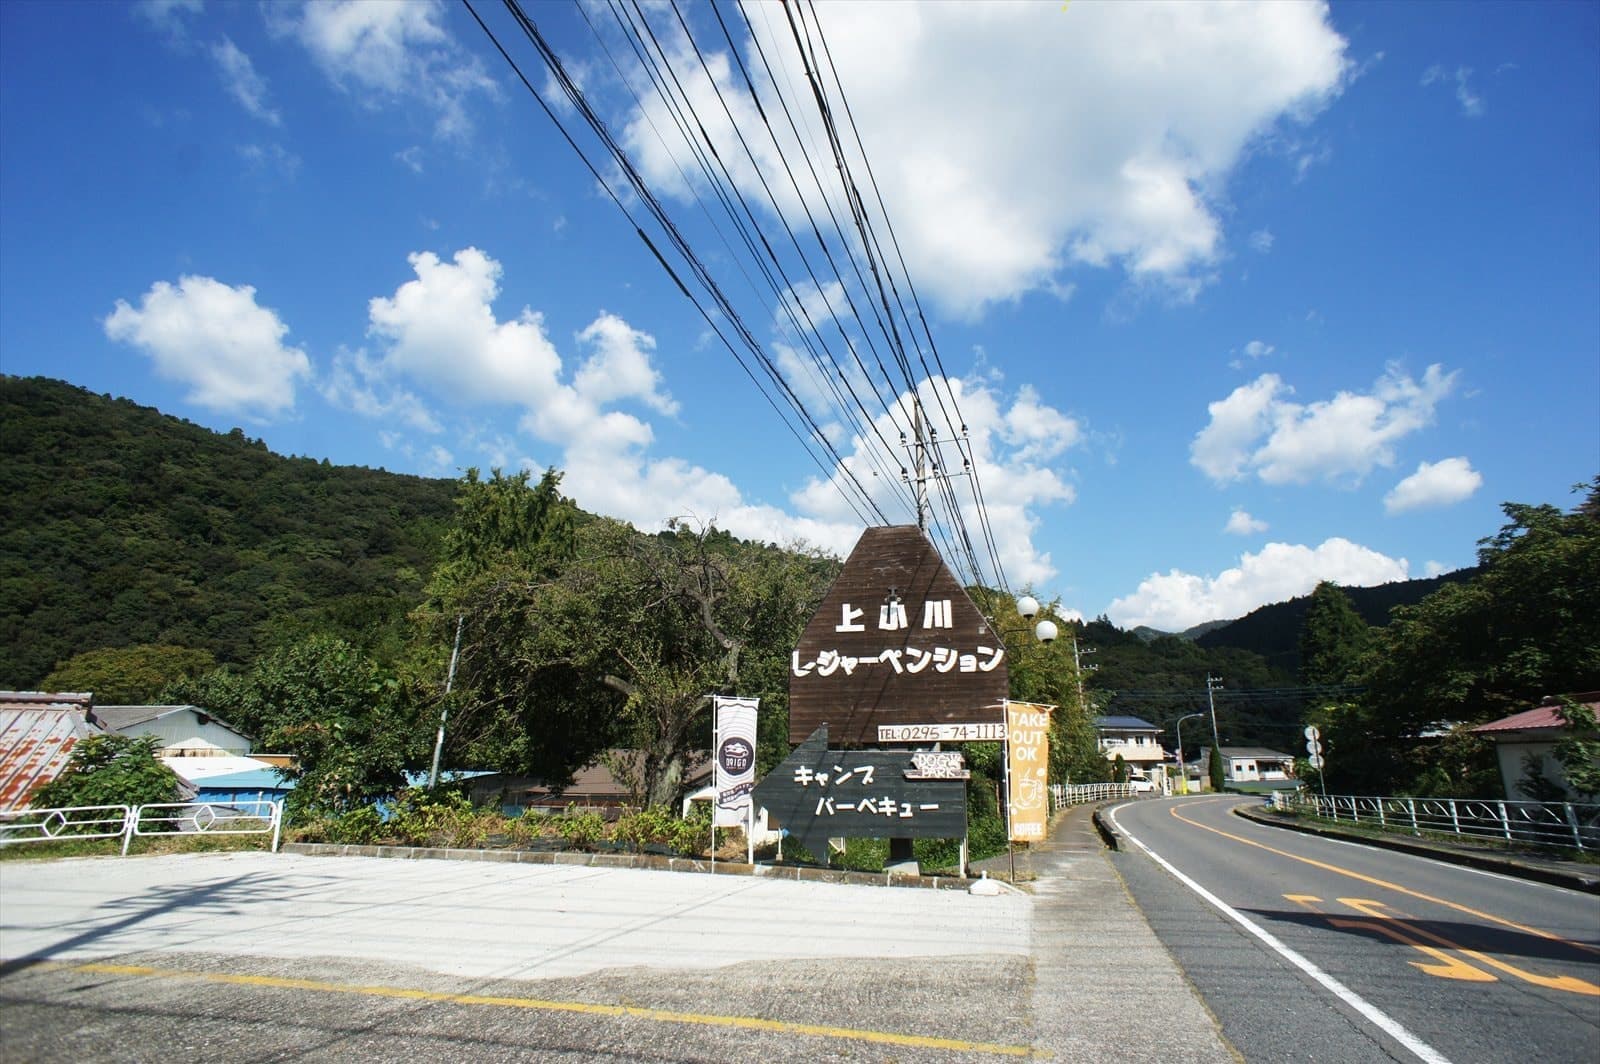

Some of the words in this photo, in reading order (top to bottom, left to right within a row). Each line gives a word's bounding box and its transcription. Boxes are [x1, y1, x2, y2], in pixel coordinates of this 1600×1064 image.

[792, 647, 1004, 677] レジャーペンション
[1010, 711, 1049, 728] TAKE
[1012, 730, 1044, 745] OUT
[918, 753, 950, 768] DOG
[1016, 747, 1037, 760] OK
[794, 765, 875, 786] キャンプ
[922, 766, 955, 778] PARK
[815, 796, 939, 817] バーベキュー
